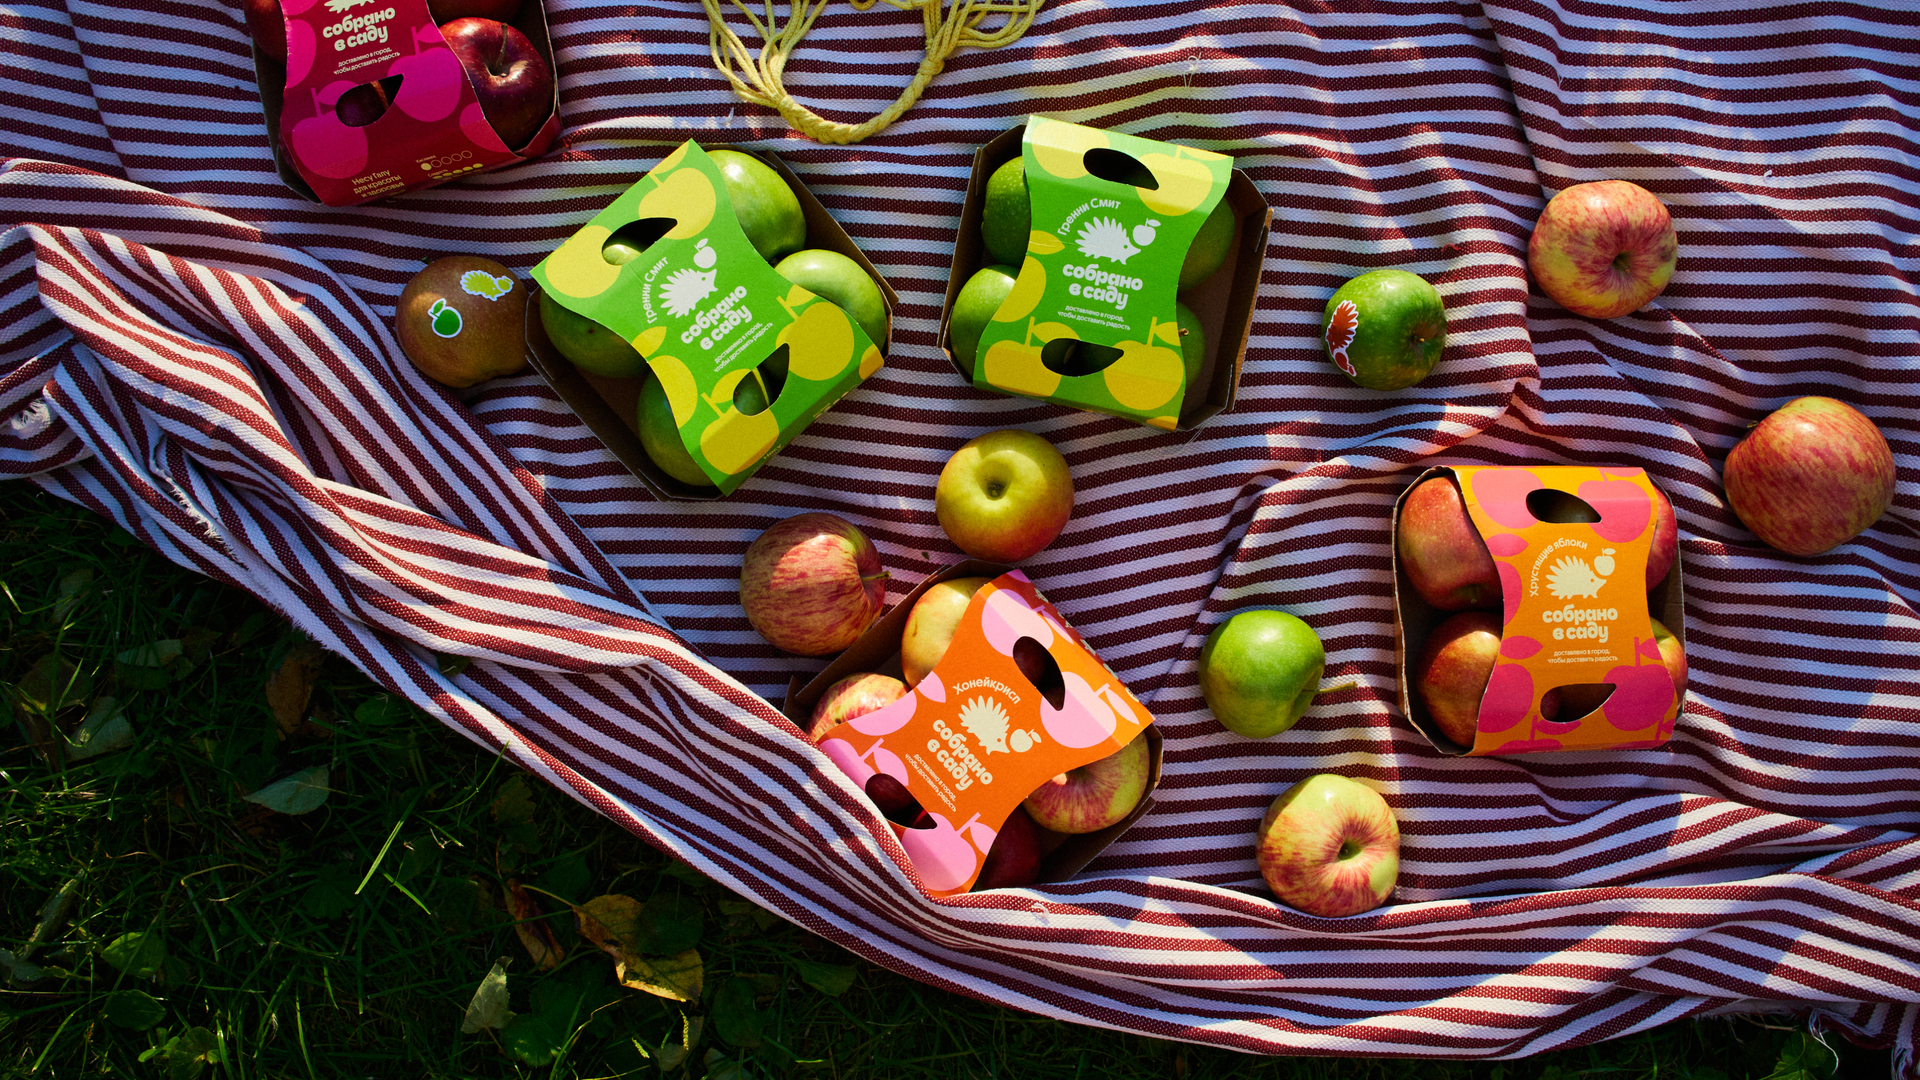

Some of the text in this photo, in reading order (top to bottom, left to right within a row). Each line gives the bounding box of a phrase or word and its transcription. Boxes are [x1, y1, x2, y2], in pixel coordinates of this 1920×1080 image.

[323, 8, 395, 38] собрано
[334, 25, 388, 51] в саду
[333, 52, 400, 75] чтобы доставить радость
[339, 54, 369, 67] доставлено
[352, 170, 390, 185] Несу Галу
[354, 175, 401, 194] для красоты
[367, 182, 404, 196] здоровья
[1057, 198, 1121, 235] Гренни Смит
[642, 257, 669, 324] Гренни Смит
[1062, 264, 1143, 291] собрано
[1068, 283, 1128, 310] в саду
[681, 286, 747, 344] собрано
[1058, 311, 1130, 331] чтобы доставить радость
[1065, 305, 1099, 316] доставлено
[1104, 313, 1124, 322] город,
[700, 305, 752, 350] в саду
[714, 322, 773, 373] чтобы доставить радость
[715, 338, 743, 364] доставлено
[745, 322, 763, 337] город,
[1529, 538, 1588, 597] Хрустящие яблоки
[1542, 604, 1618, 625] собрано
[1552, 622, 1608, 643] в саду
[952, 677, 1021, 704] Хонейкрисп
[927, 739, 974, 791] в саду
[933, 719, 993, 785] собрано
[905, 754, 956, 812] чтобы доставить радость
[913, 754, 940, 782] доставлено
[941, 783, 956, 801] город,
